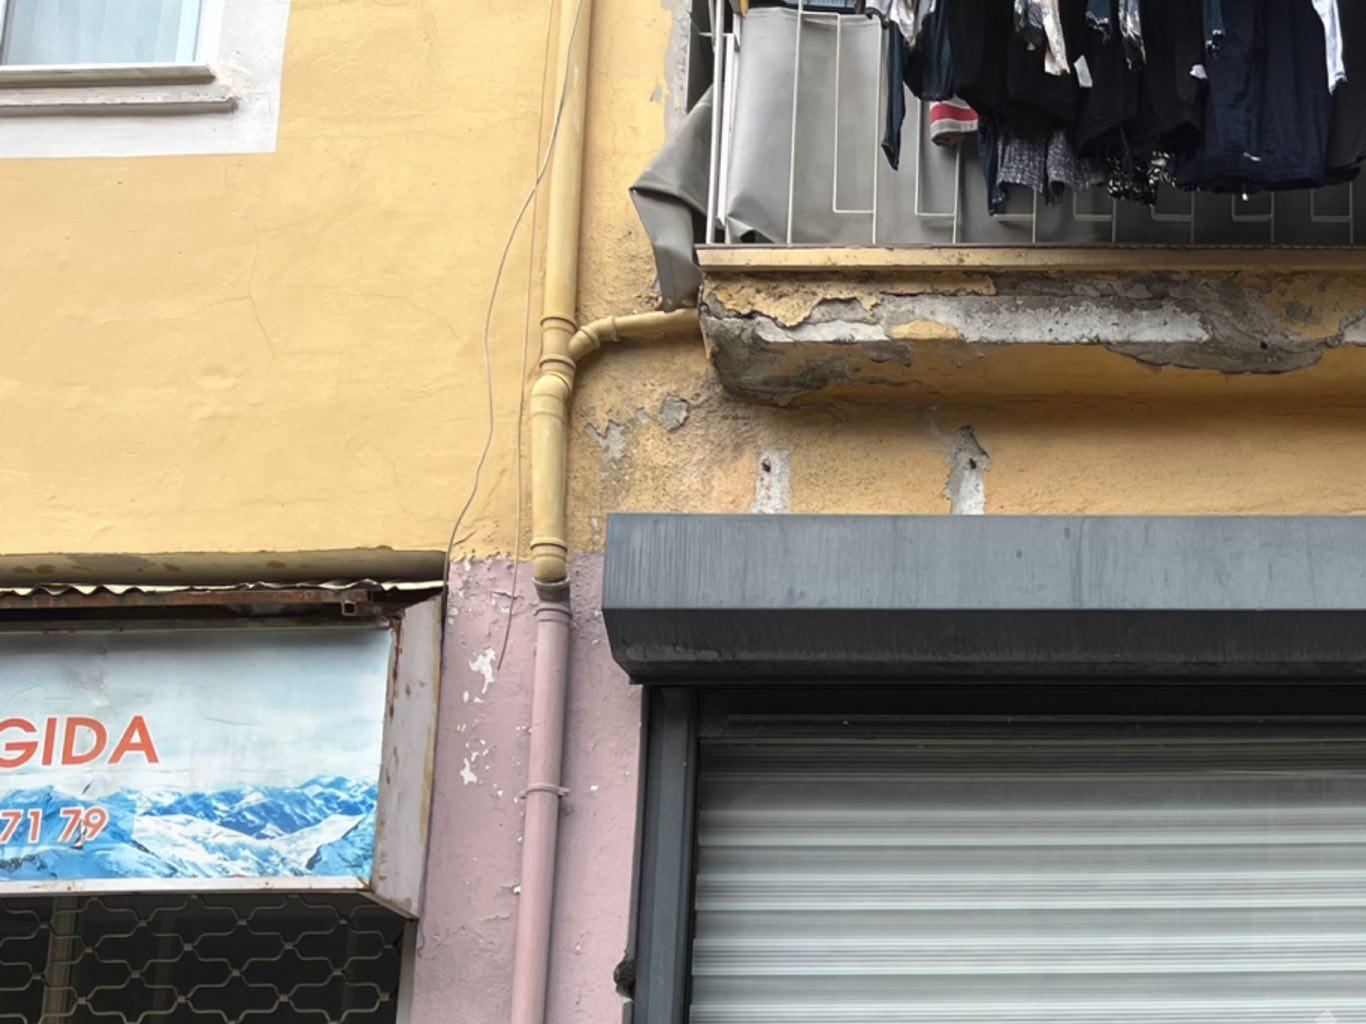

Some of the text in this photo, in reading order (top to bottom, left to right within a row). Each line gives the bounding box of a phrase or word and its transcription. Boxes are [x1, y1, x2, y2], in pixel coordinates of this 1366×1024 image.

[0, 715, 160, 768] GIDA
[0, 806, 109, 843] 71 79
